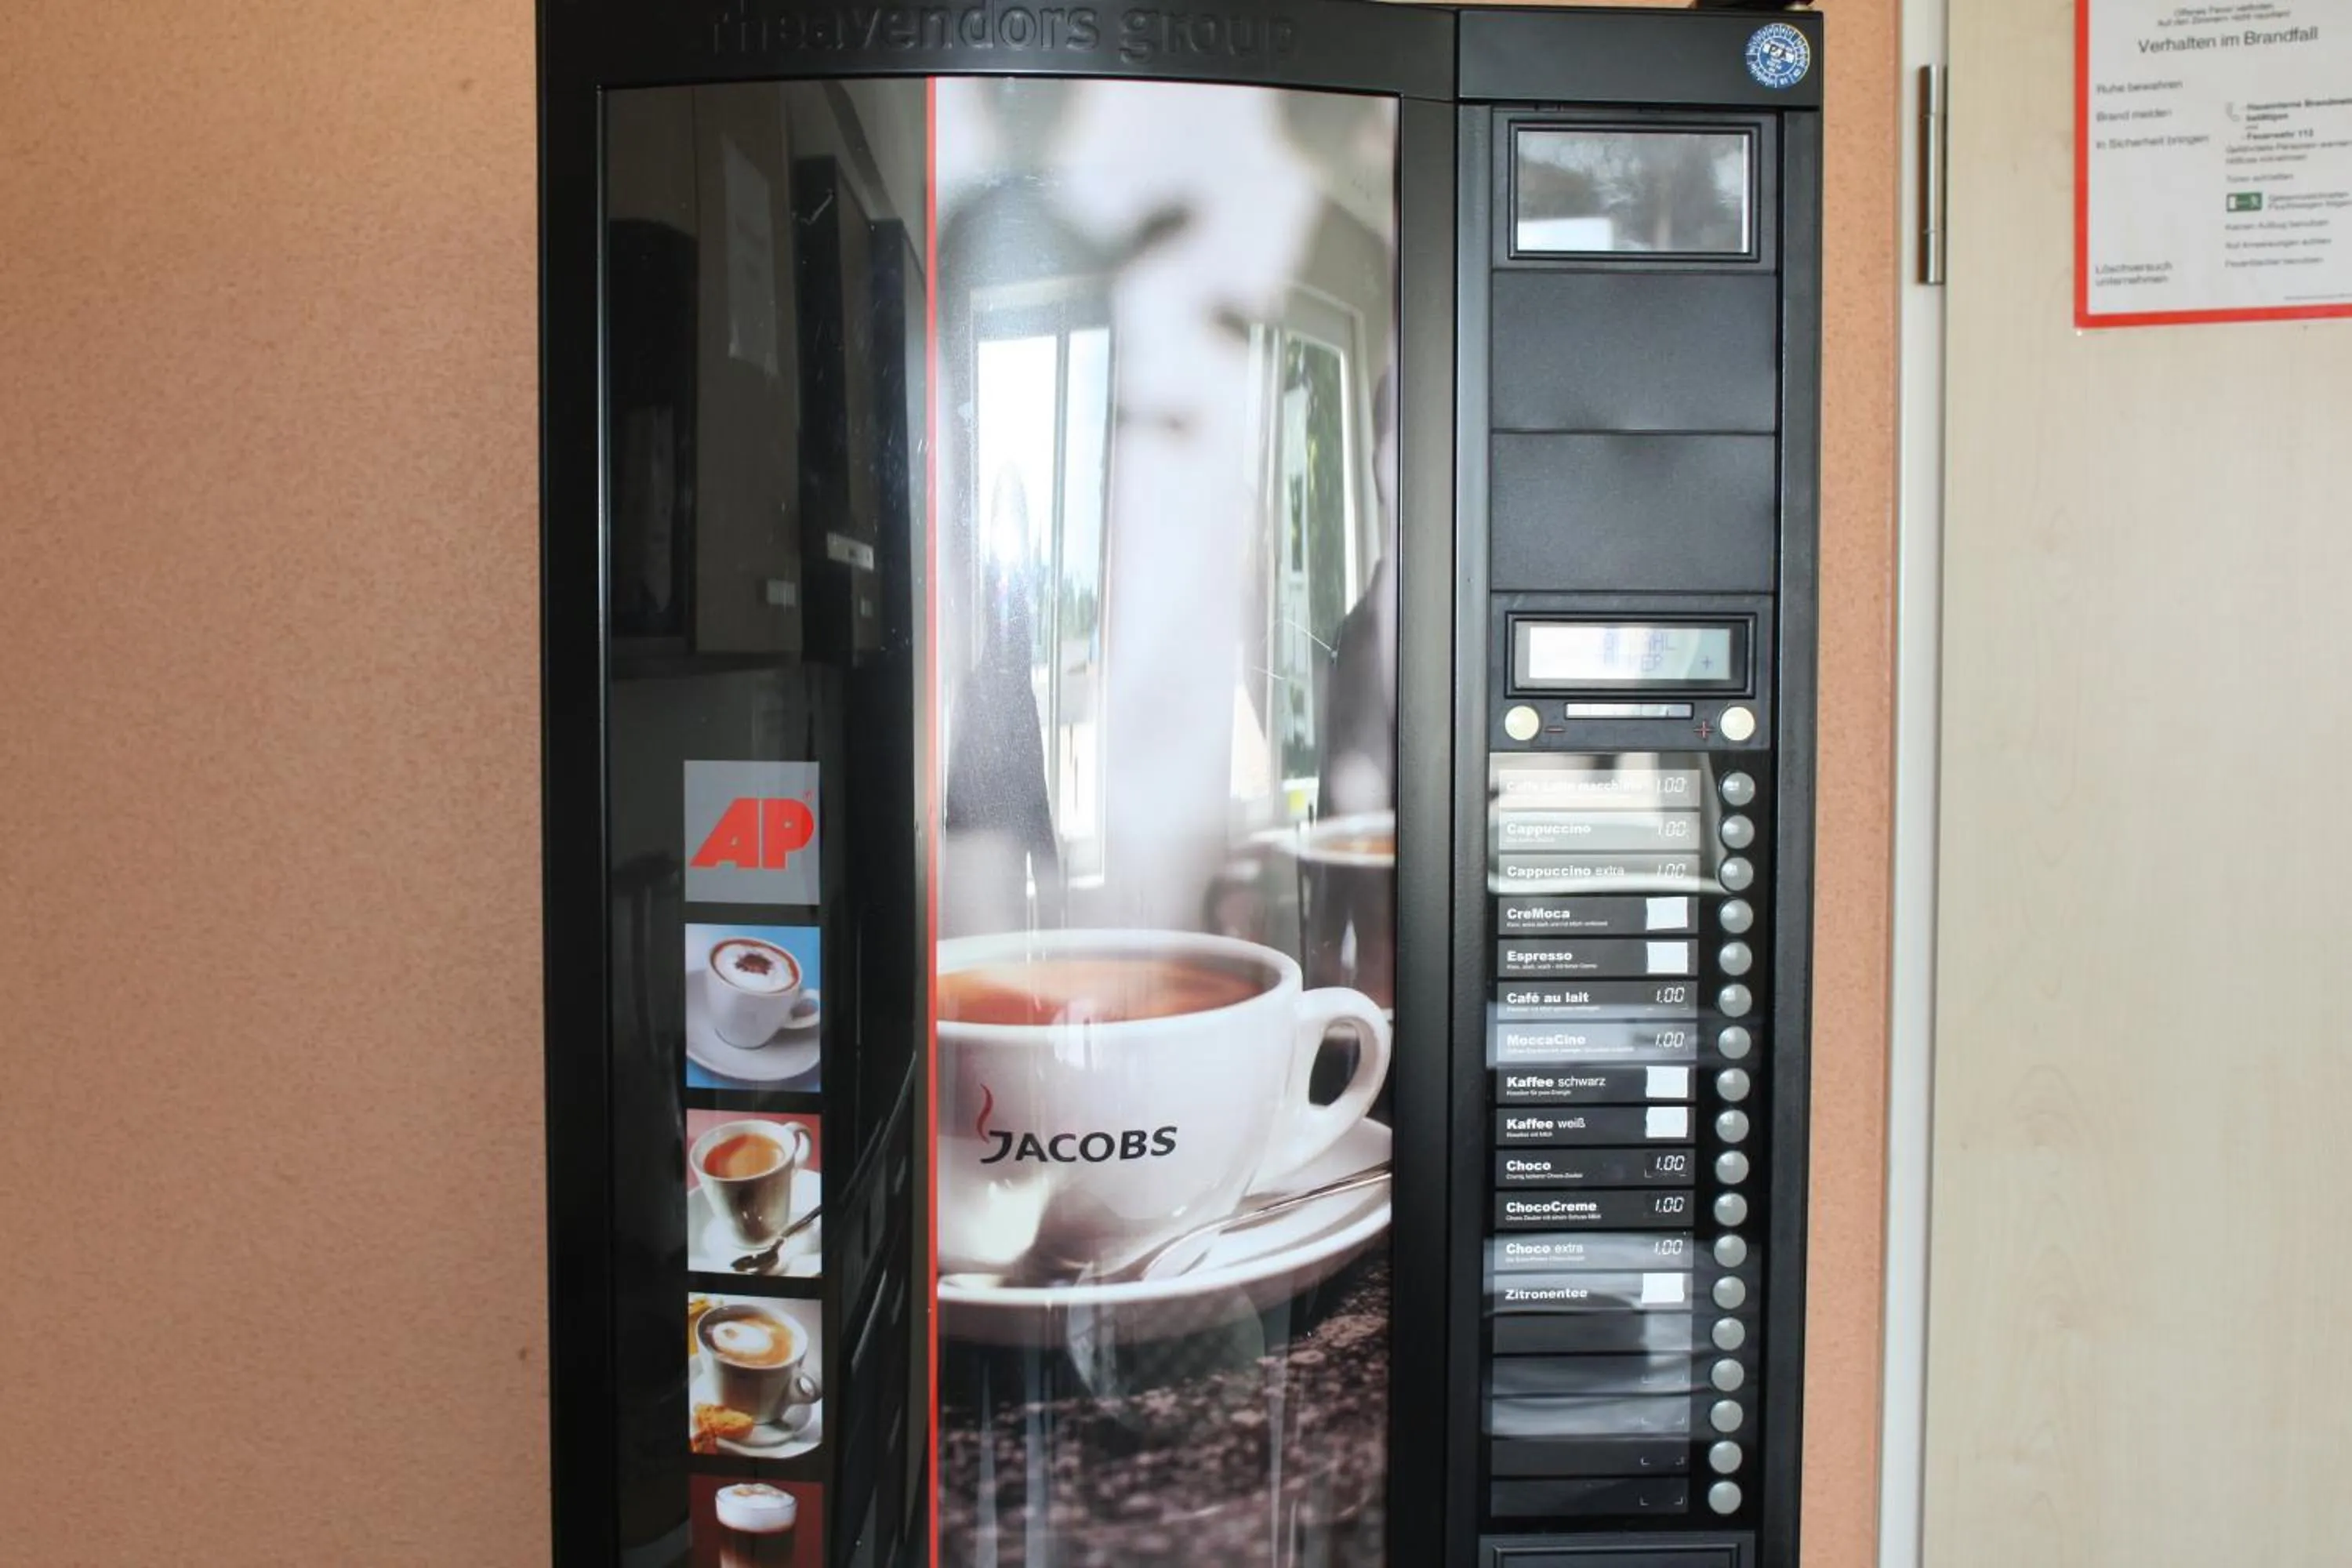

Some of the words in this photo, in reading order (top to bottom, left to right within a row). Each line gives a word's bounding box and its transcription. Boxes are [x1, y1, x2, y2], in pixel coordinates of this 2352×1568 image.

[1119, 6, 1301, 63] group
[2138, 34, 2216, 53] Verhalten
[2220, 33, 2240, 47] im
[2244, 27, 2319, 45] Brandfall
[2096, 83, 2125, 94] Ruhe
[2096, 111, 2129, 122] Brand
[690, 797, 815, 869] AP
[1506, 823, 1592, 837] Cappuccino
[1507, 866, 1591, 880] Cappuccino
[1506, 908, 1570, 920] CreMoca
[1506, 951, 1573, 964] Espresso
[1506, 992, 1540, 1004] Café
[1566, 992, 1589, 1003] lait
[1506, 1033, 1586, 1047] MoccaCino
[1506, 1076, 1554, 1087] Kaffee
[1558, 1076, 1606, 1087] schwarz
[1506, 1118, 1554, 1130] Kaffee
[1558, 1117, 1586, 1129] weiß
[980, 1126, 1178, 1164] JACOBS
[1506, 1160, 1552, 1171] Choco
[1506, 1201, 1597, 1213] ChocoCreme
[1506, 1243, 1551, 1254] Choco
[1555, 1243, 1584, 1254] extra
[1505, 1289, 1588, 1301] Zitronentee
